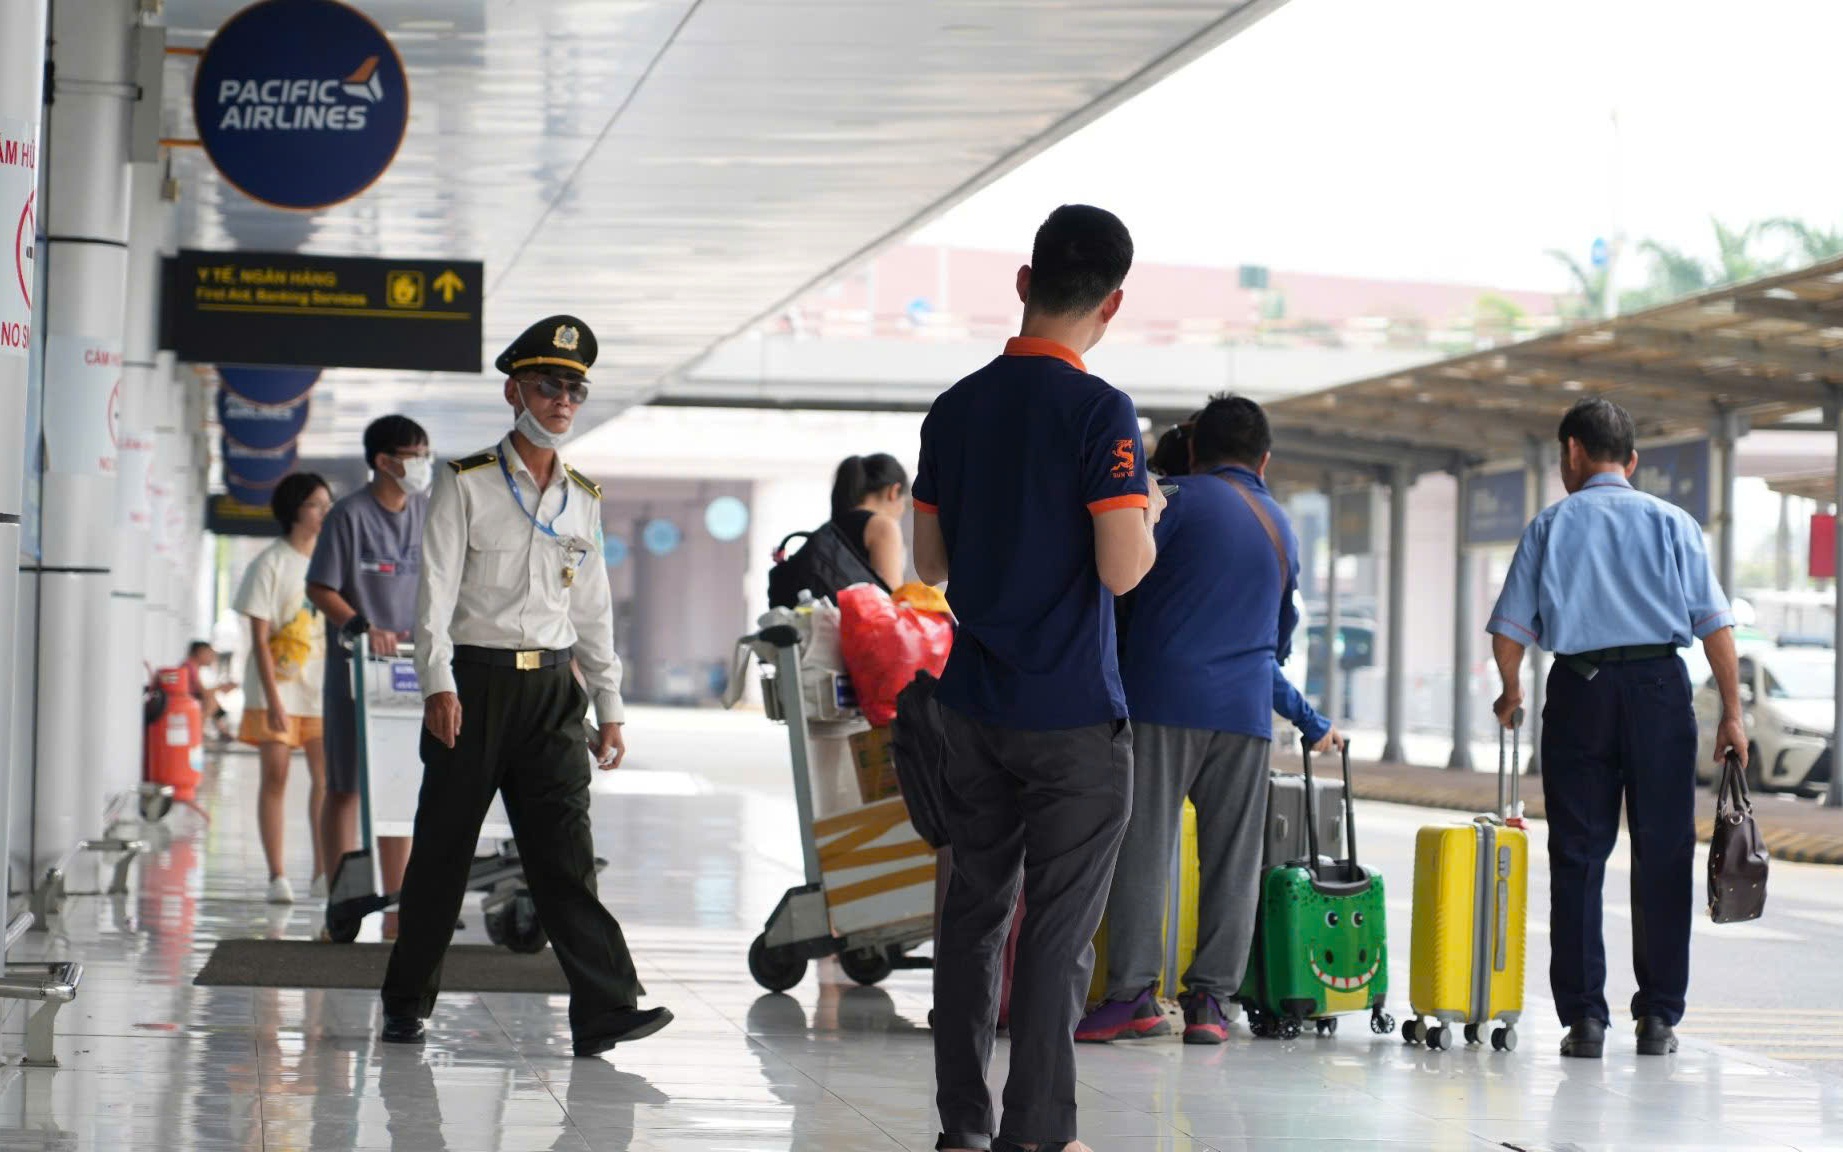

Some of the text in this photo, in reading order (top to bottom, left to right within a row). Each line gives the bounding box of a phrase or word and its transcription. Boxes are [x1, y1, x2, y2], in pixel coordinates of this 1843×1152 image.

[218, 79, 340, 103] PACIFIC
[219, 105, 367, 129] AIRLINES
[196, 286, 225, 299] First
[255, 288, 309, 306] Banking
[311, 290, 368, 306] Services
[1, 321, 20, 347] NO
